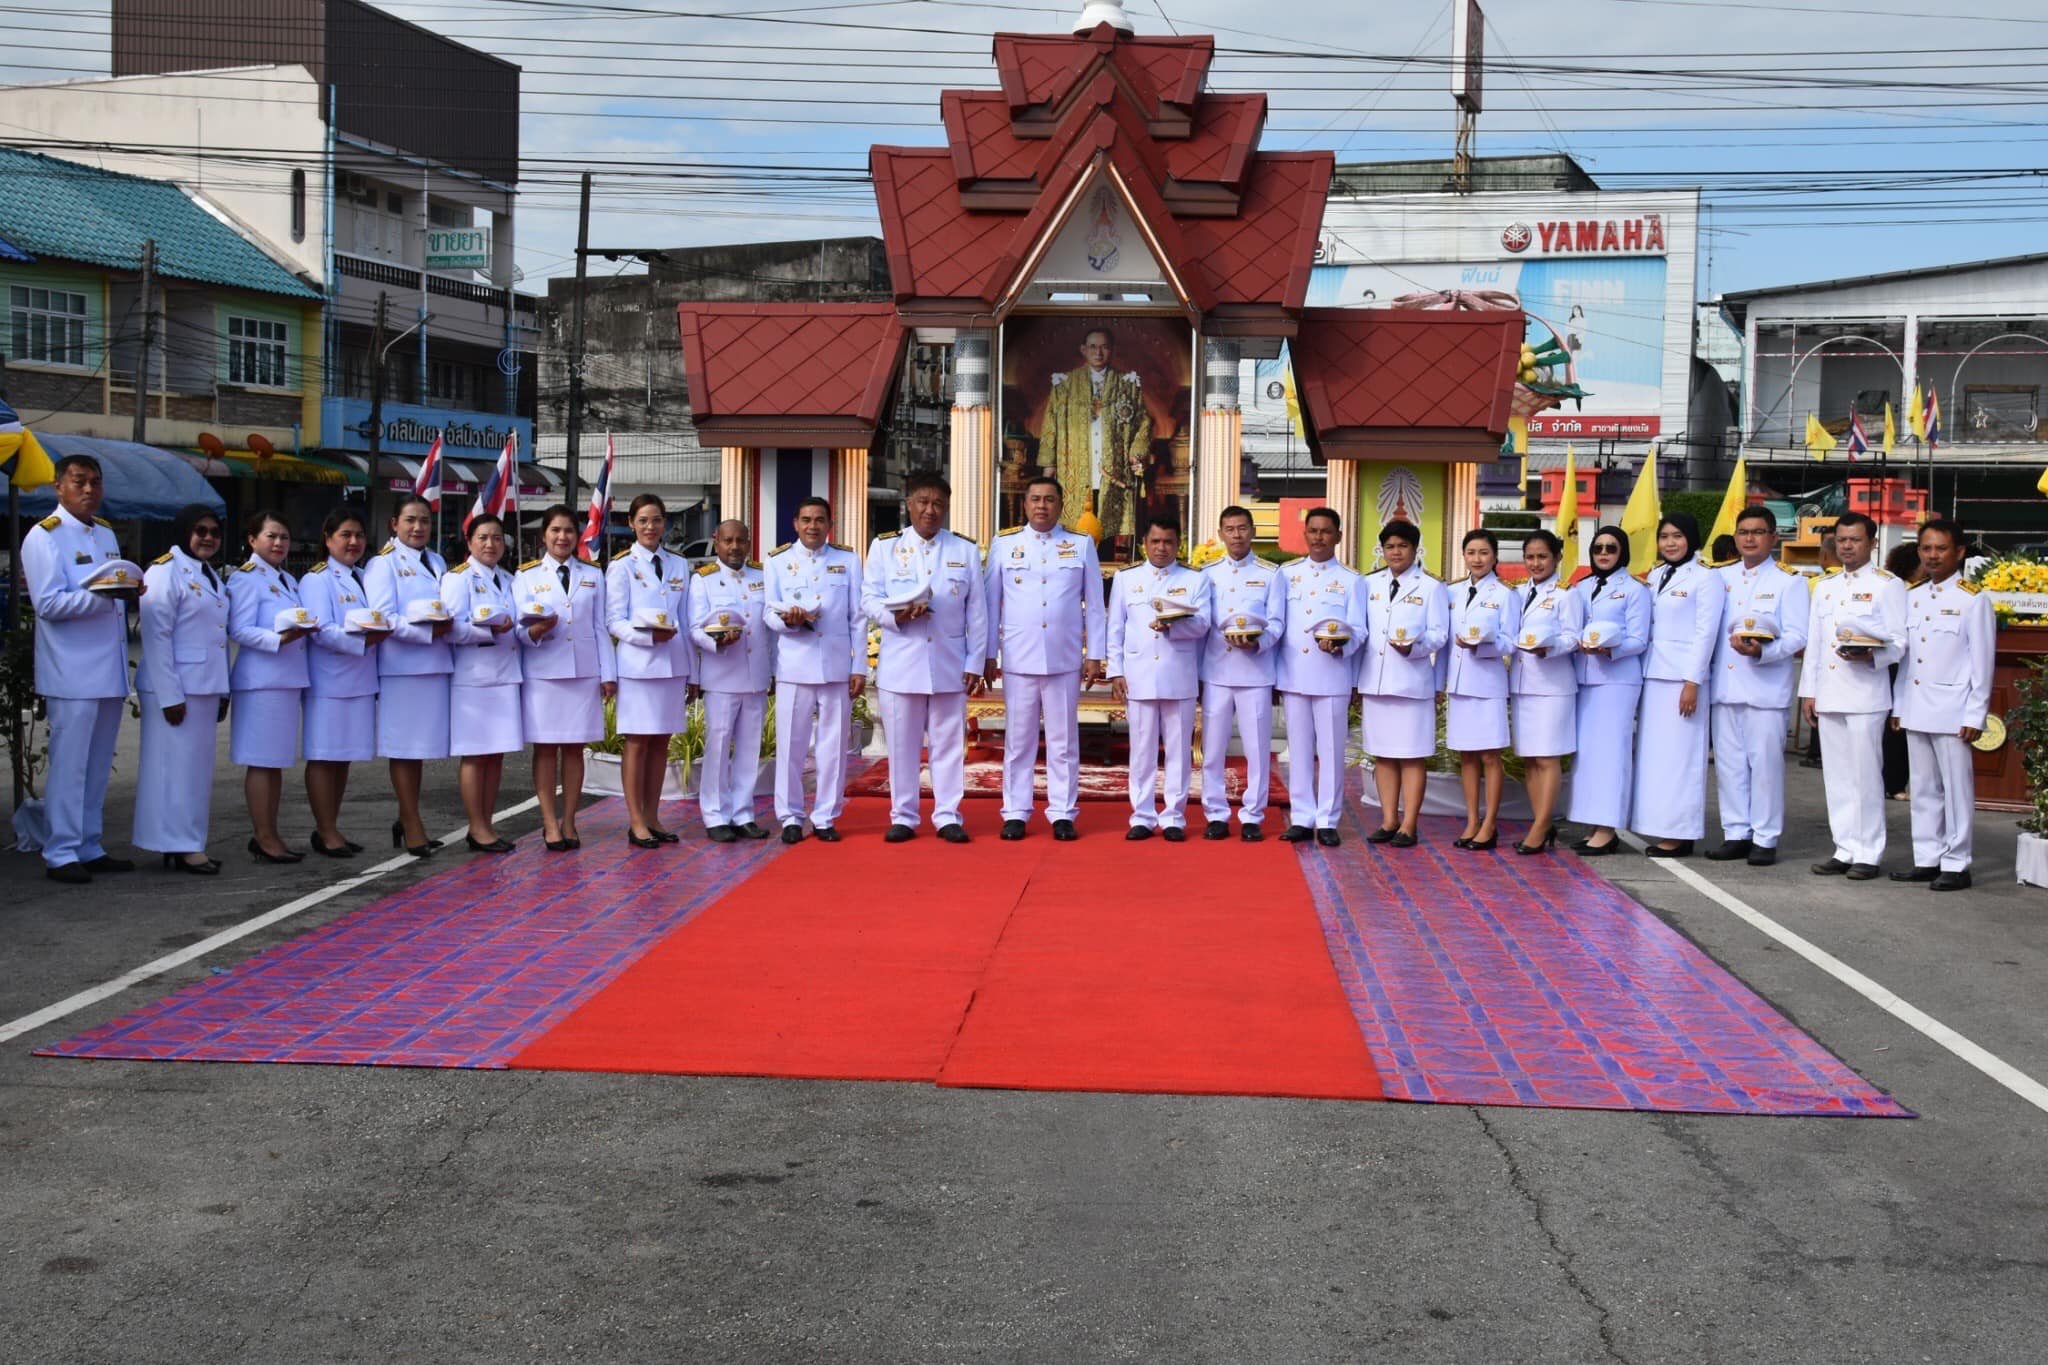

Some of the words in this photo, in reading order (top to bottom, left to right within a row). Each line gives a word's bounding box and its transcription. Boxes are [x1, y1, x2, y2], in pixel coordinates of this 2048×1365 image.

[428, 231, 483, 252] ขายยา
[1537, 219, 1664, 252] YAMAHA
[1553, 280, 1625, 305] FINN
[1551, 419, 1582, 432] จำกัด
